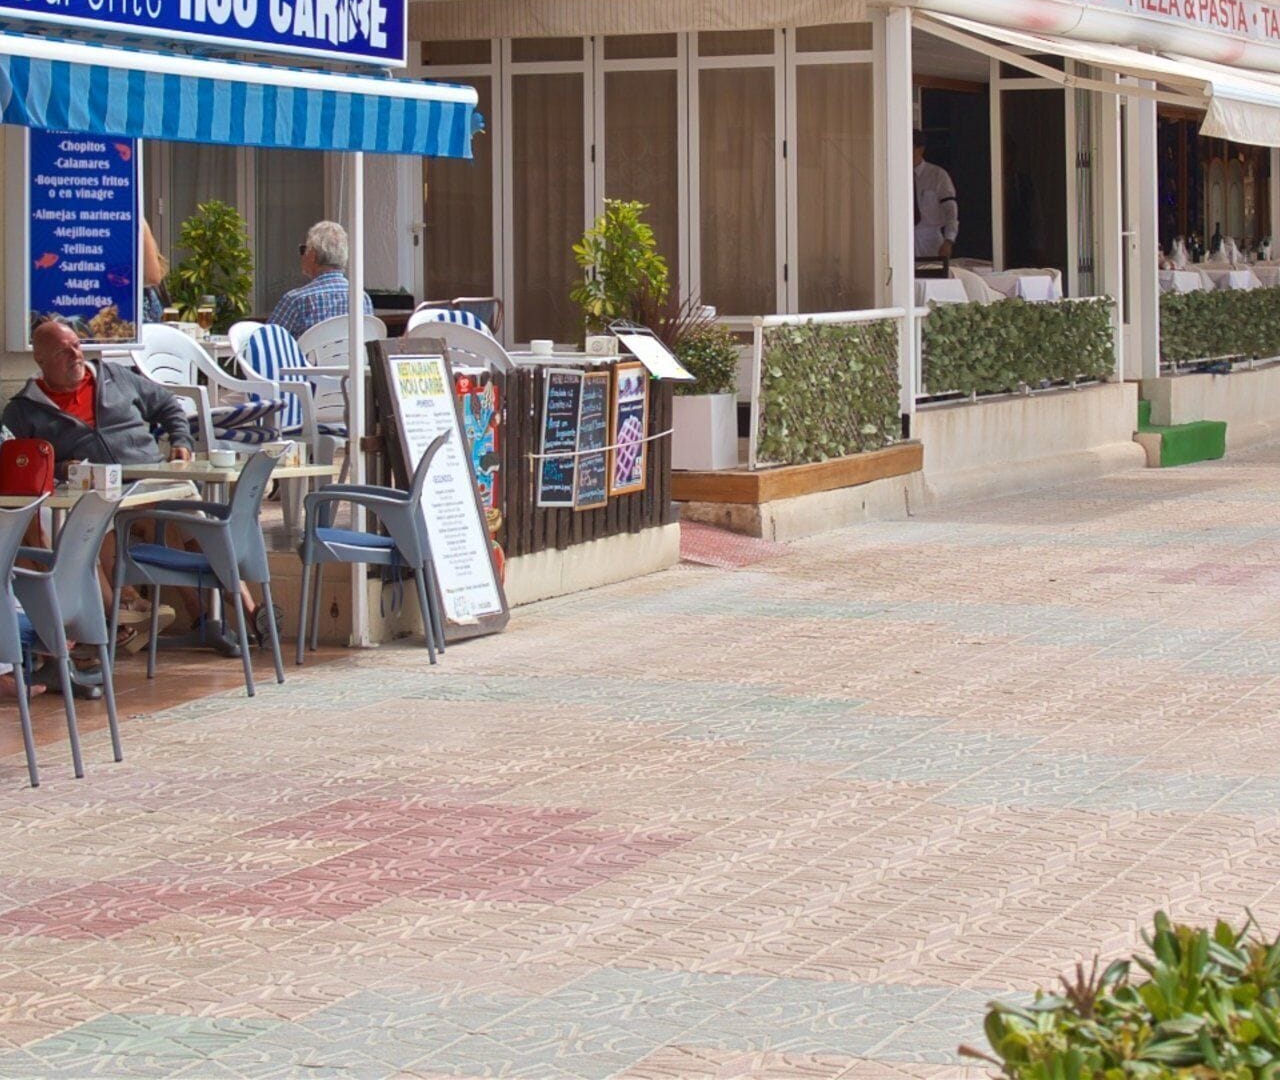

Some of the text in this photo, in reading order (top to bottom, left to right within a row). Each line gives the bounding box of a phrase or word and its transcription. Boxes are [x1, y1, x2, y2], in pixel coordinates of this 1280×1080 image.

[58, 141, 106, 153] -Chopitos
[54, 157, 110, 169] -Calamares
[34, 175, 129, 188] -Boquerones fritos
[48, 188, 114, 201] o en vinagre
[32, 209, 131, 222] -Almejas marineras
[53, 227, 110, 239] -Mejillones
[60, 243, 103, 254] -Tellinas
[59, 260, 105, 272] -Sardinas
[64, 278, 100, 291] -Magra
[52, 294, 112, 308] -Albóndigas
